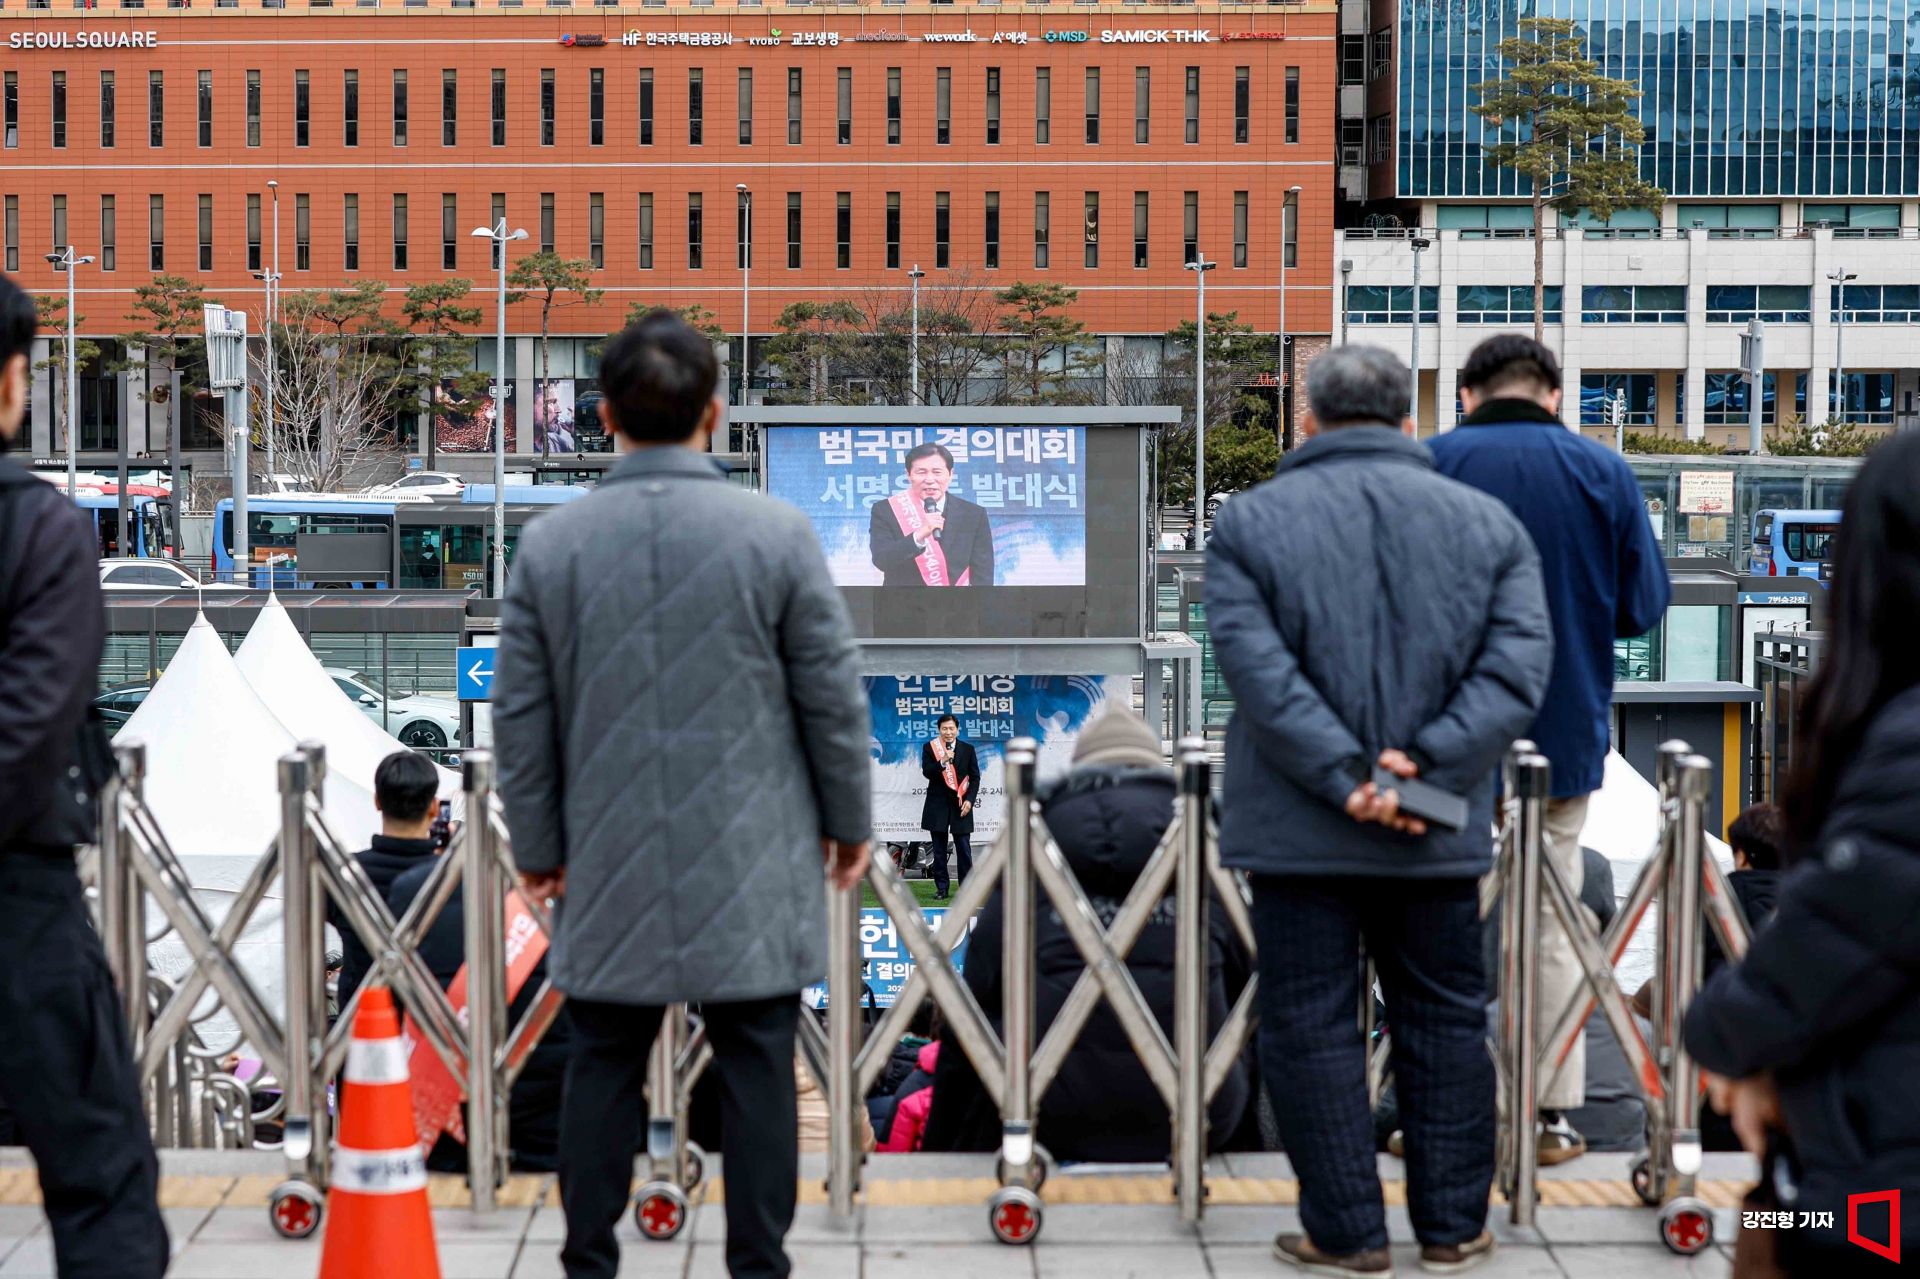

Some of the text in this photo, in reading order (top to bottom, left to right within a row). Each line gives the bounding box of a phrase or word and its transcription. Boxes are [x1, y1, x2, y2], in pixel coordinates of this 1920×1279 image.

[10, 31, 158, 49] SEOUL SQUARE
[622, 32, 642, 46] HF
[646, 32, 733, 46] 한국주택금융공사
[749, 37, 780, 46] KYOBO
[791, 31, 839, 46] 교보생명
[923, 29, 977, 42] wework
[1058, 31, 1088, 42] MSD
[1101, 29, 1169, 43] SAMICK
[1172, 29, 1210, 43] THK
[935, 427, 1076, 464] 결의대회
[971, 472, 1078, 508] 발대식
[896, 695, 1014, 716] 범국민 결의대회
[965, 719, 1015, 738] 발대식
